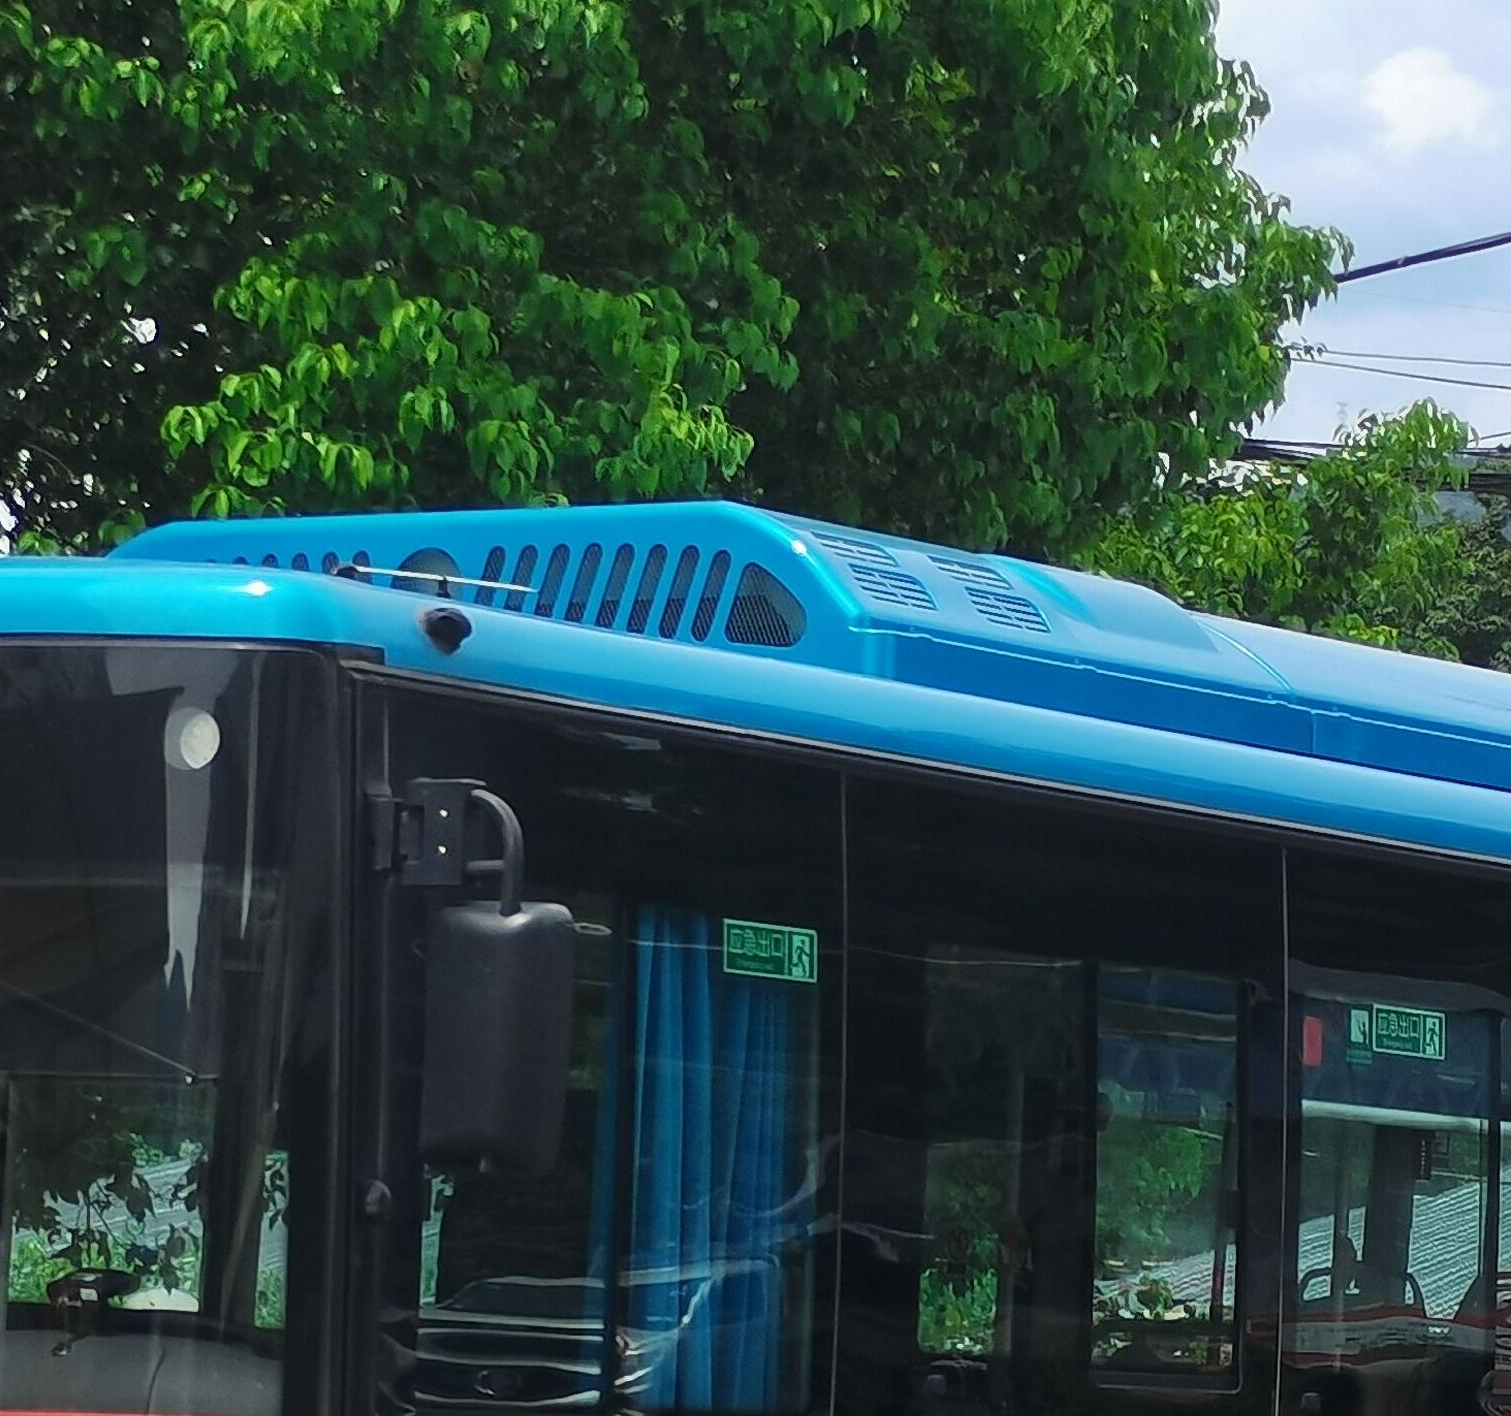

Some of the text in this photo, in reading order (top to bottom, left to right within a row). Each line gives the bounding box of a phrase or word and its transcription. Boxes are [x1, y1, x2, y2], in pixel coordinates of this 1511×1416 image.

[728, 928, 785, 958] 应急出口
[1377, 1012, 1420, 1038] 应急出口
